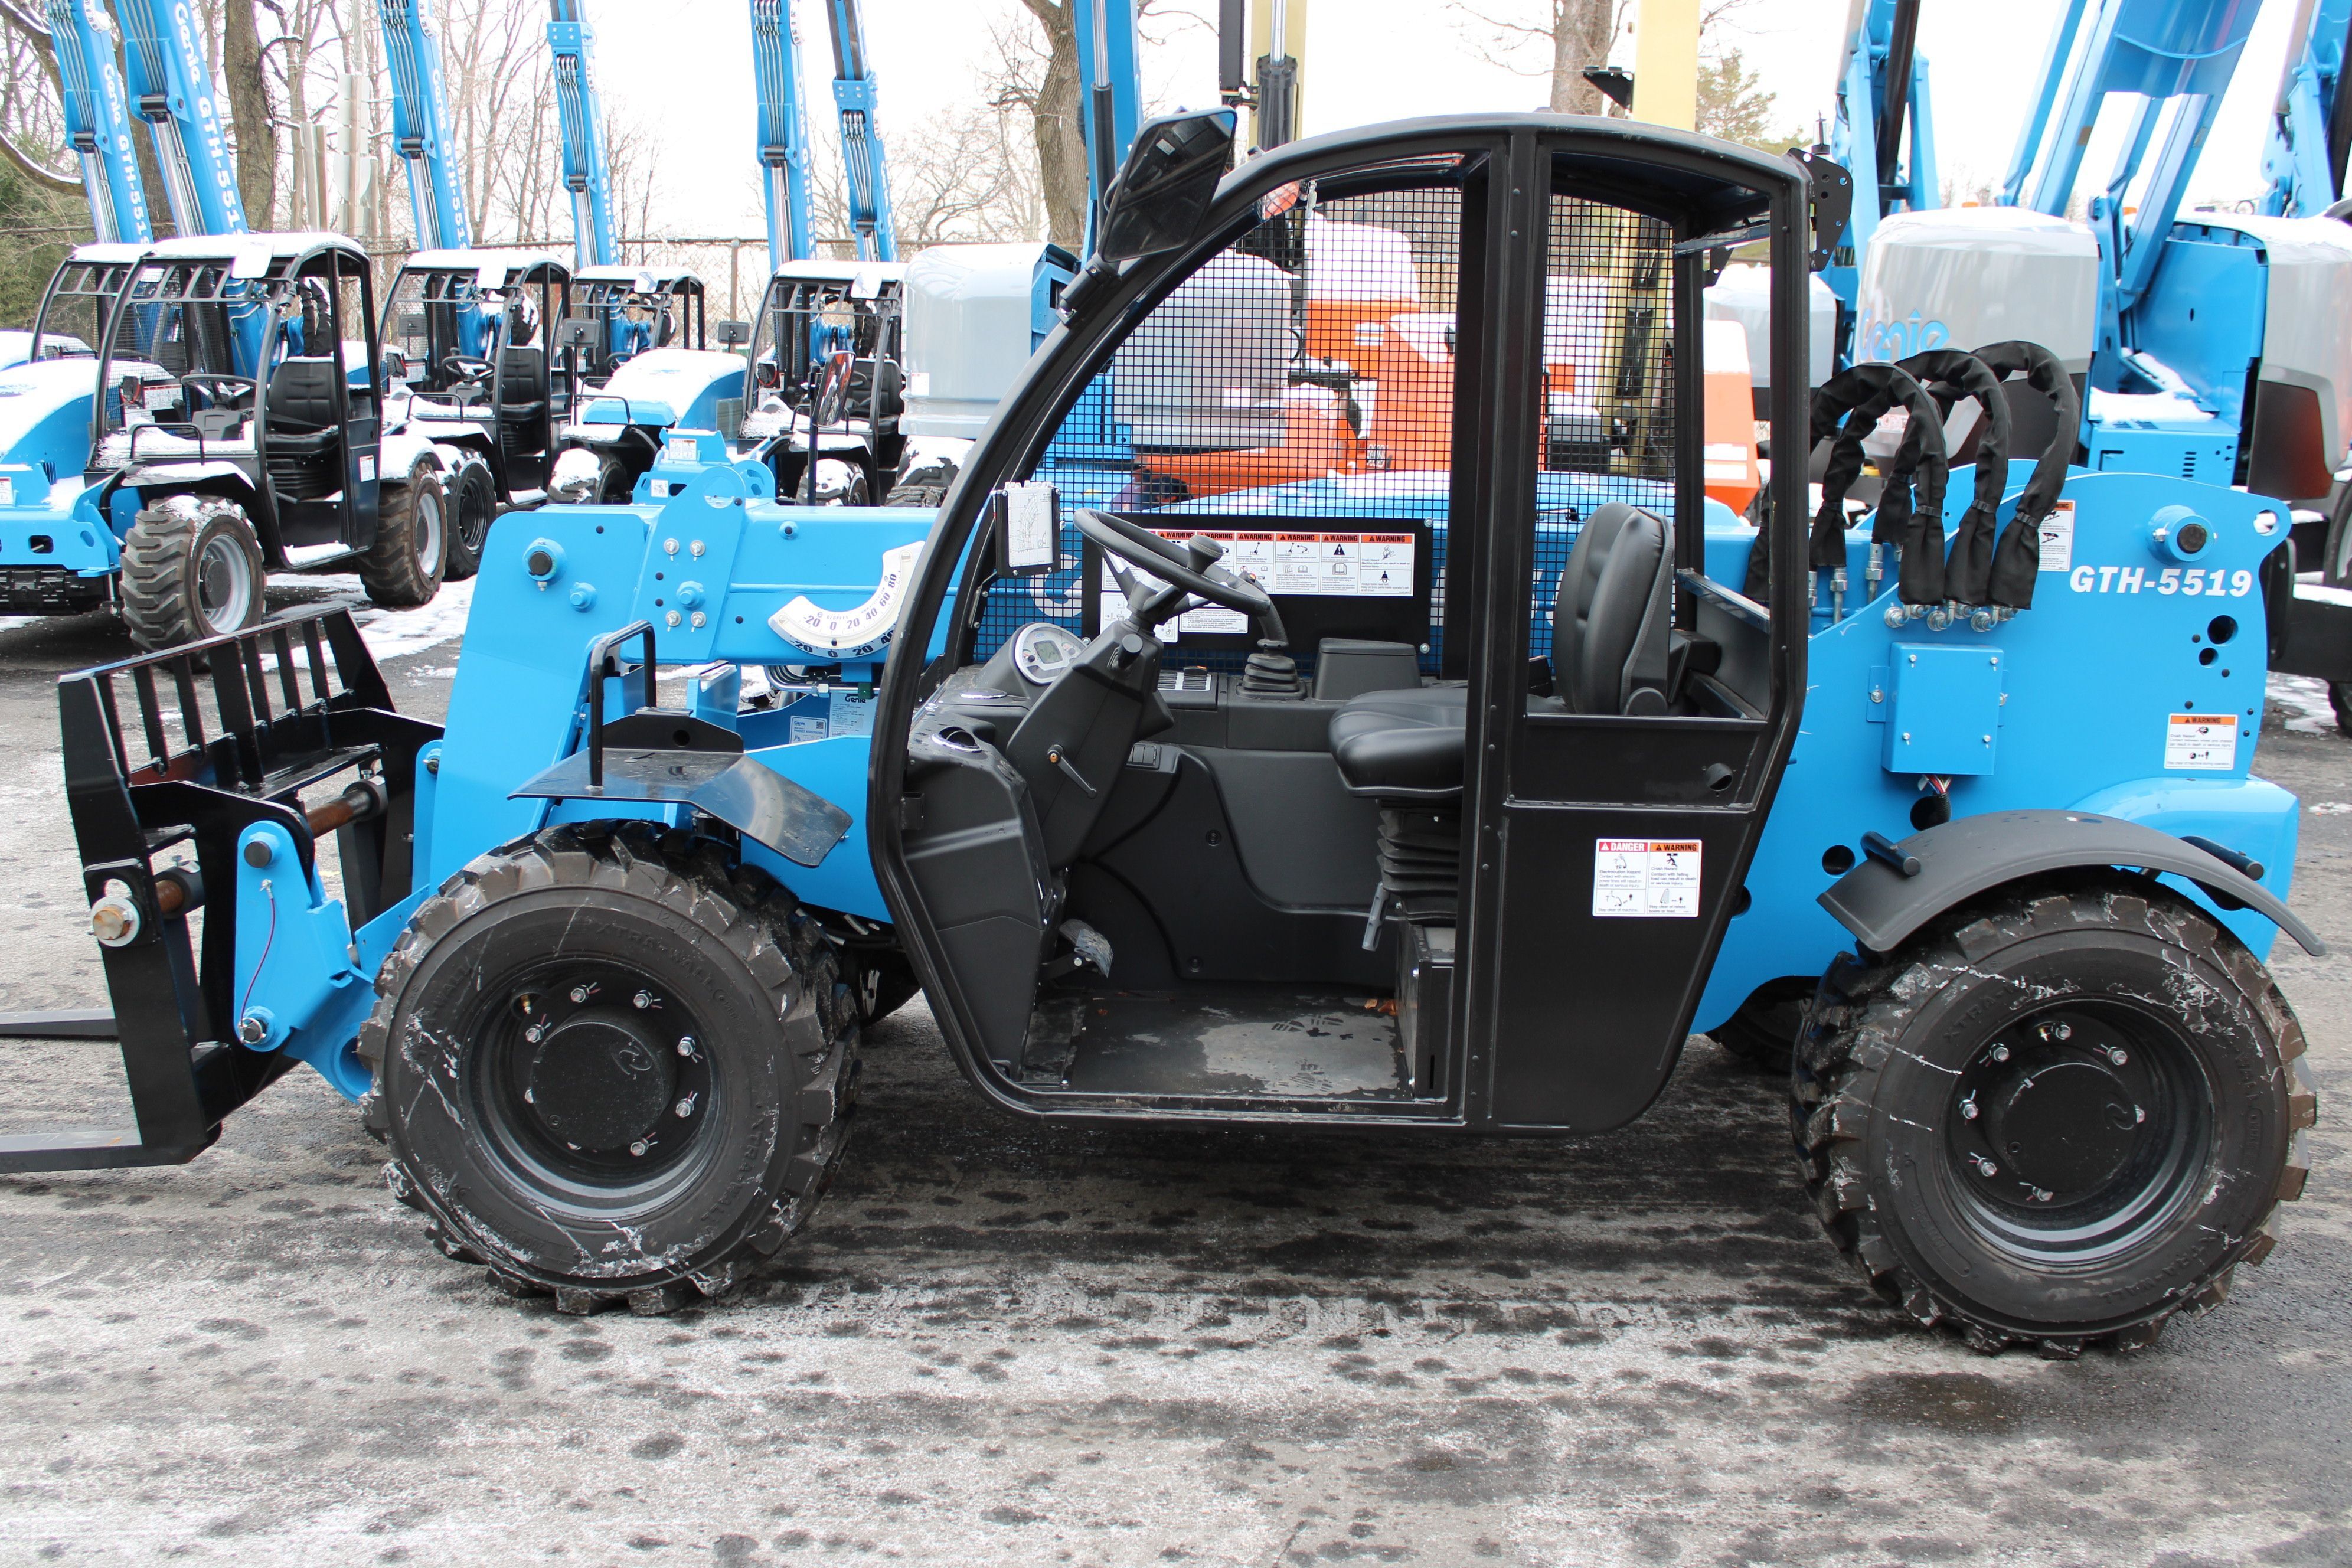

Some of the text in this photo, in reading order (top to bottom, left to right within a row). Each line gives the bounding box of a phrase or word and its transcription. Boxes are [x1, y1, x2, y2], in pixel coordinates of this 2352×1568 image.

[175, 2, 201, 88] Genie
[104, 63, 122, 129] Genie
[433, 68, 447, 131] Genie
[888, 573, 897, 588] 80
[2069, 565, 2252, 597] GTH-5519
[879, 592, 890, 607] 60
[866, 607, 877, 620] 40
[829, 621, 837, 630] 0
[847, 618, 860, 629] 20
[852, 645, 874, 656] 20
[845, 695, 867, 704] Genie
[1611, 842, 1645, 851] DANGER
